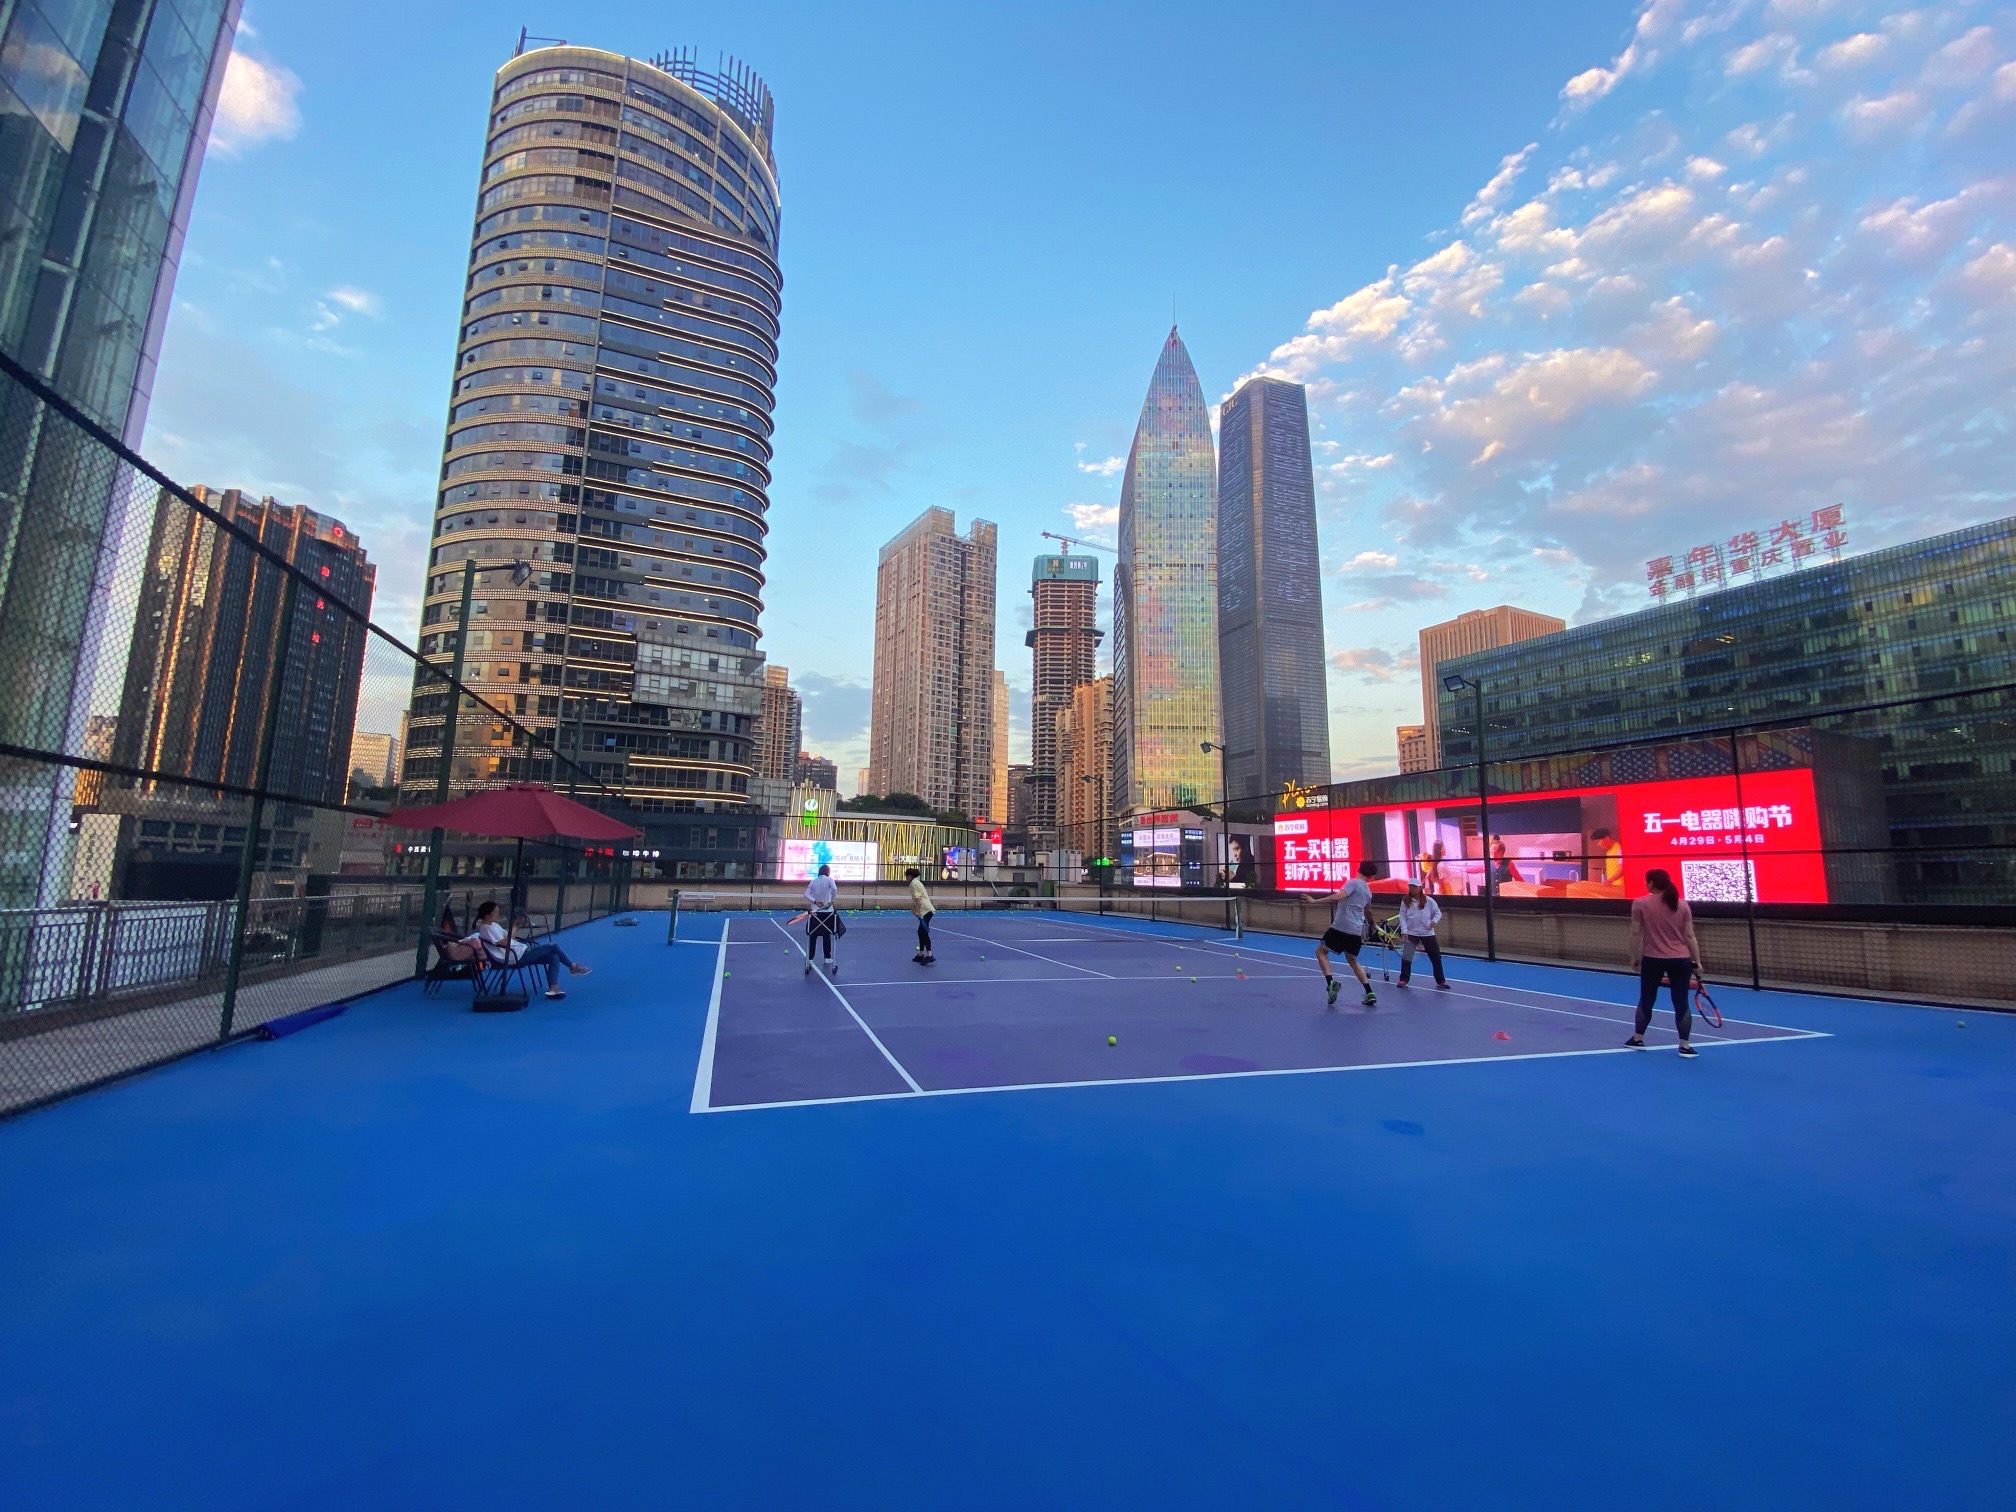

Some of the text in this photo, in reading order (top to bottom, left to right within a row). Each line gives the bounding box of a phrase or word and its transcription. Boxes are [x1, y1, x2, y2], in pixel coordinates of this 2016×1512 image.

[1647, 503, 1846, 580] 嘉年华大厦
[1643, 804, 1793, 833] 五一电器嗨购节
[1284, 838, 1349, 860] 五一买电器
[1284, 862, 1351, 881] 到苏宁易购
